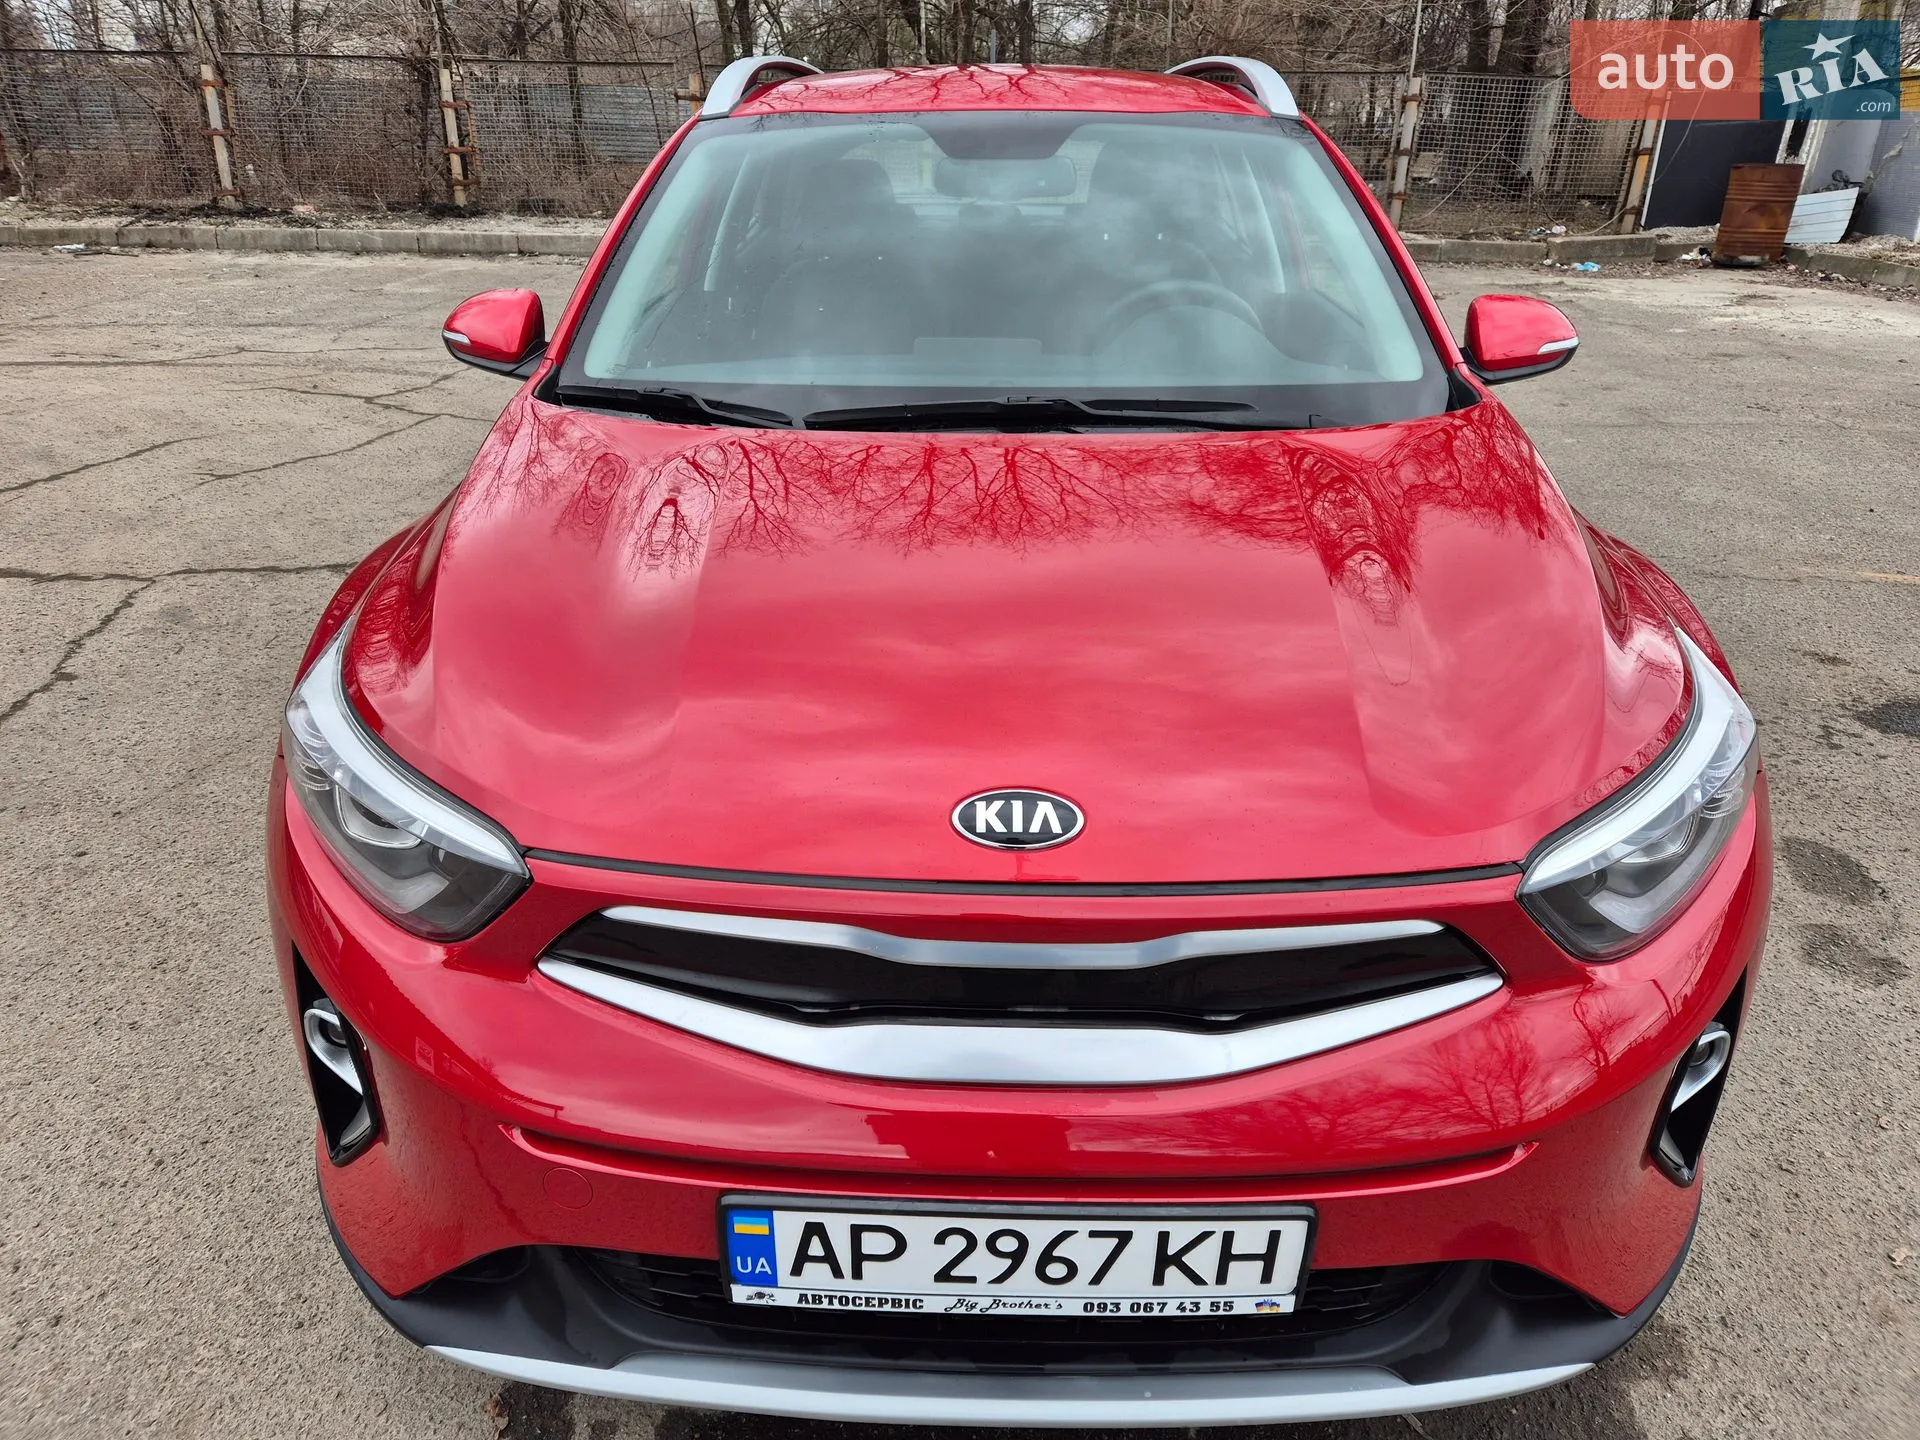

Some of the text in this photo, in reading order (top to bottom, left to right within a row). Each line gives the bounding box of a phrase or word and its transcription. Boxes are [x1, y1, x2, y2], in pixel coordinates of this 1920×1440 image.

[974, 800, 1063, 834] KIA
[790, 1221, 1282, 1287] AP 2967 KH
[737, 1256, 772, 1276] UA
[797, 1293, 924, 1311] АВТОСЕРВІС
[944, 1297, 1064, 1315] Big Brother's
[1083, 1300, 1235, 1315] 093 067 43 55
